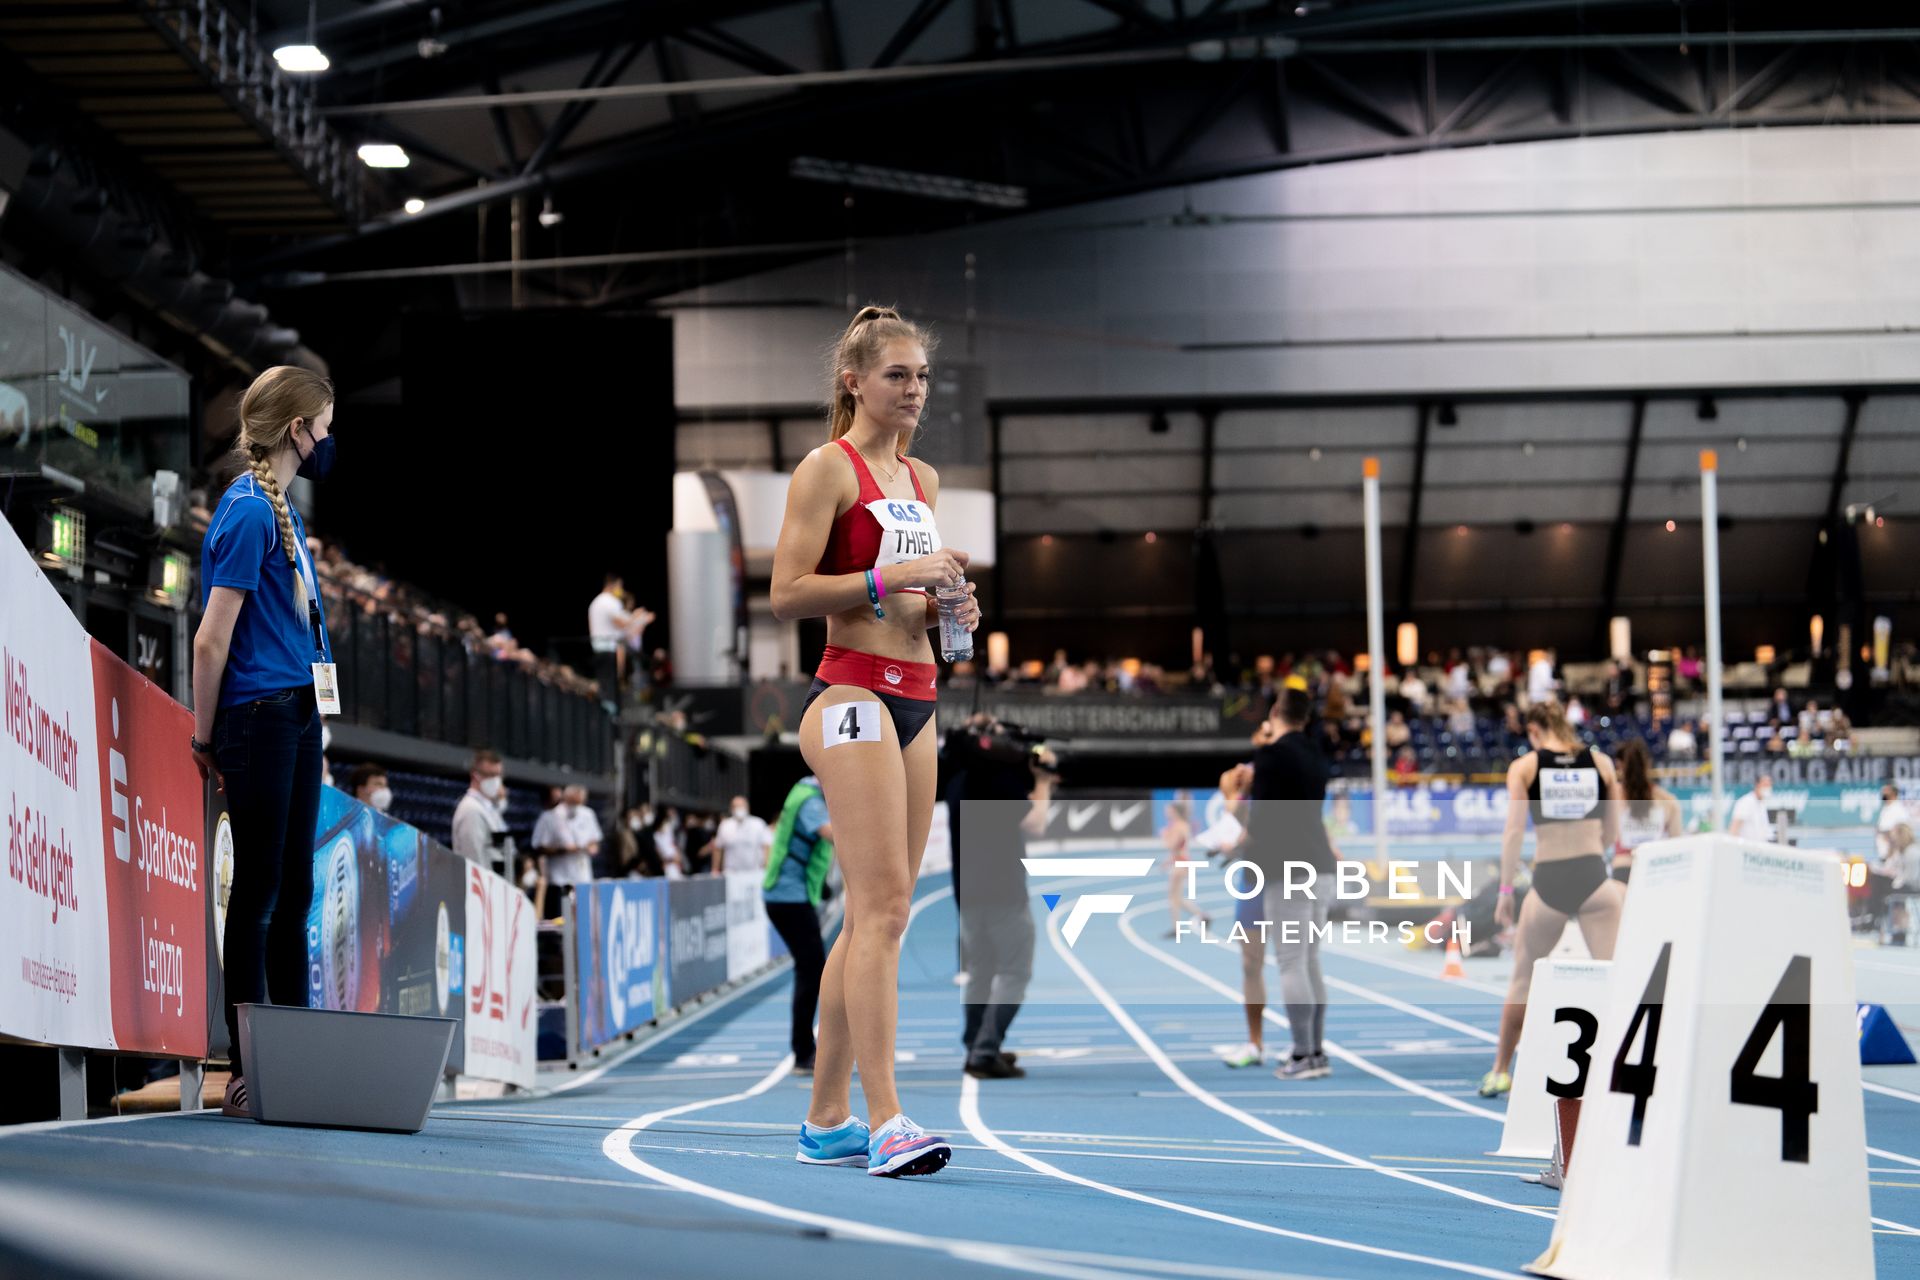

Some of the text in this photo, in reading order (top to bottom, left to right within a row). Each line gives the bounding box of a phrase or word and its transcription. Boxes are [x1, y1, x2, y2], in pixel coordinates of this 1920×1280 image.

[895, 529, 935, 555] THIEL
[4, 646, 78, 792] Weil's um mehr
[838, 707, 861, 740] 4
[1834, 757, 1887, 787] AUF
[8, 791, 78, 925] als Geld geht.
[136, 796, 197, 892] Sparkasse
[141, 916, 182, 1017] Leipzig
[1546, 1007, 1599, 1099] 3
[1610, 941, 1673, 1147] 4
[1731, 955, 1819, 1164] 4
